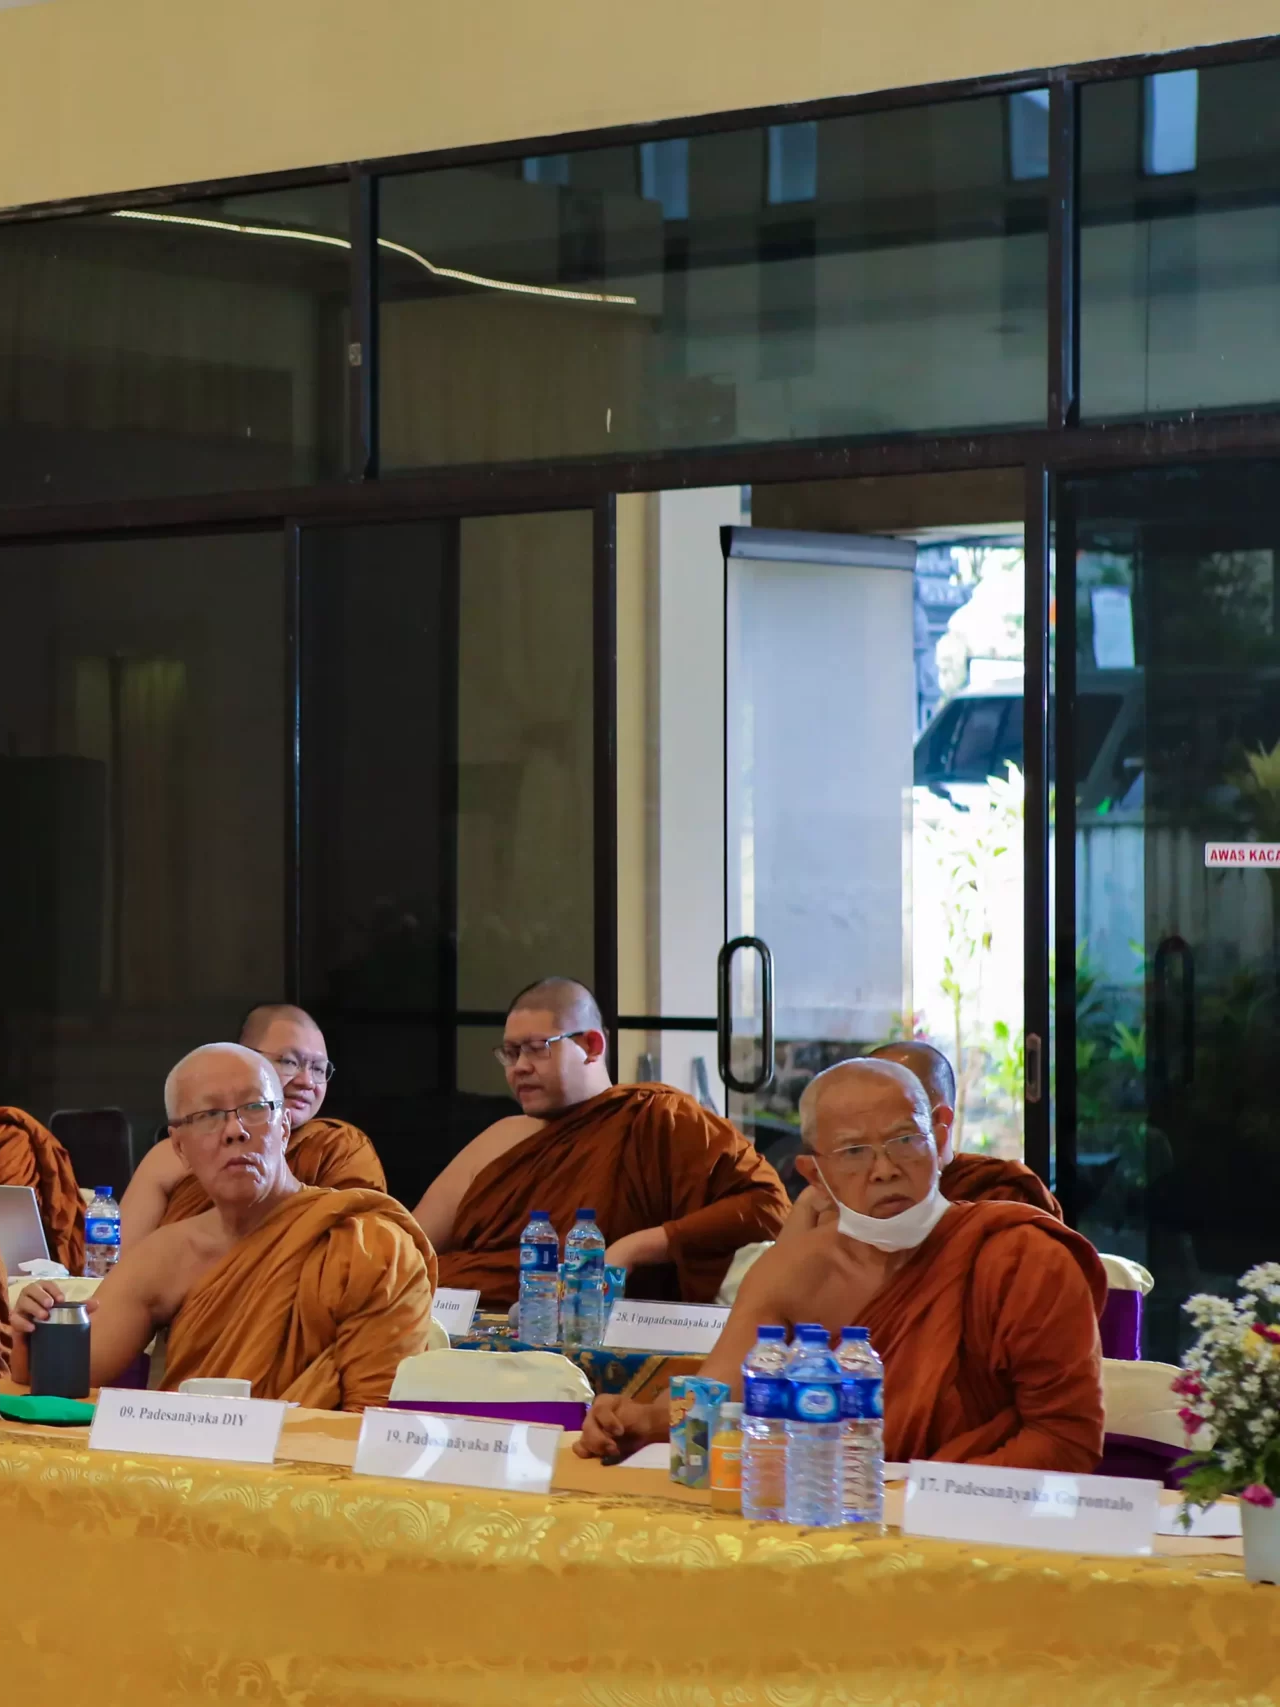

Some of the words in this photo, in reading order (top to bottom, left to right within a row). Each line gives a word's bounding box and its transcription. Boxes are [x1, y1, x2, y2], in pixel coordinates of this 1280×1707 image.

[1210, 849, 1245, 861] AWAS
[433, 1300, 460, 1311] Jatim
[120, 1405, 136, 1419] 09.
[139, 1406, 219, 1426] Padesanāyaka
[222, 1412, 248, 1426] DIY
[386, 1429, 402, 1444] 19.
[919, 1476, 940, 1492] 17.
[943, 1478, 1050, 1504] Padesanāyaka
